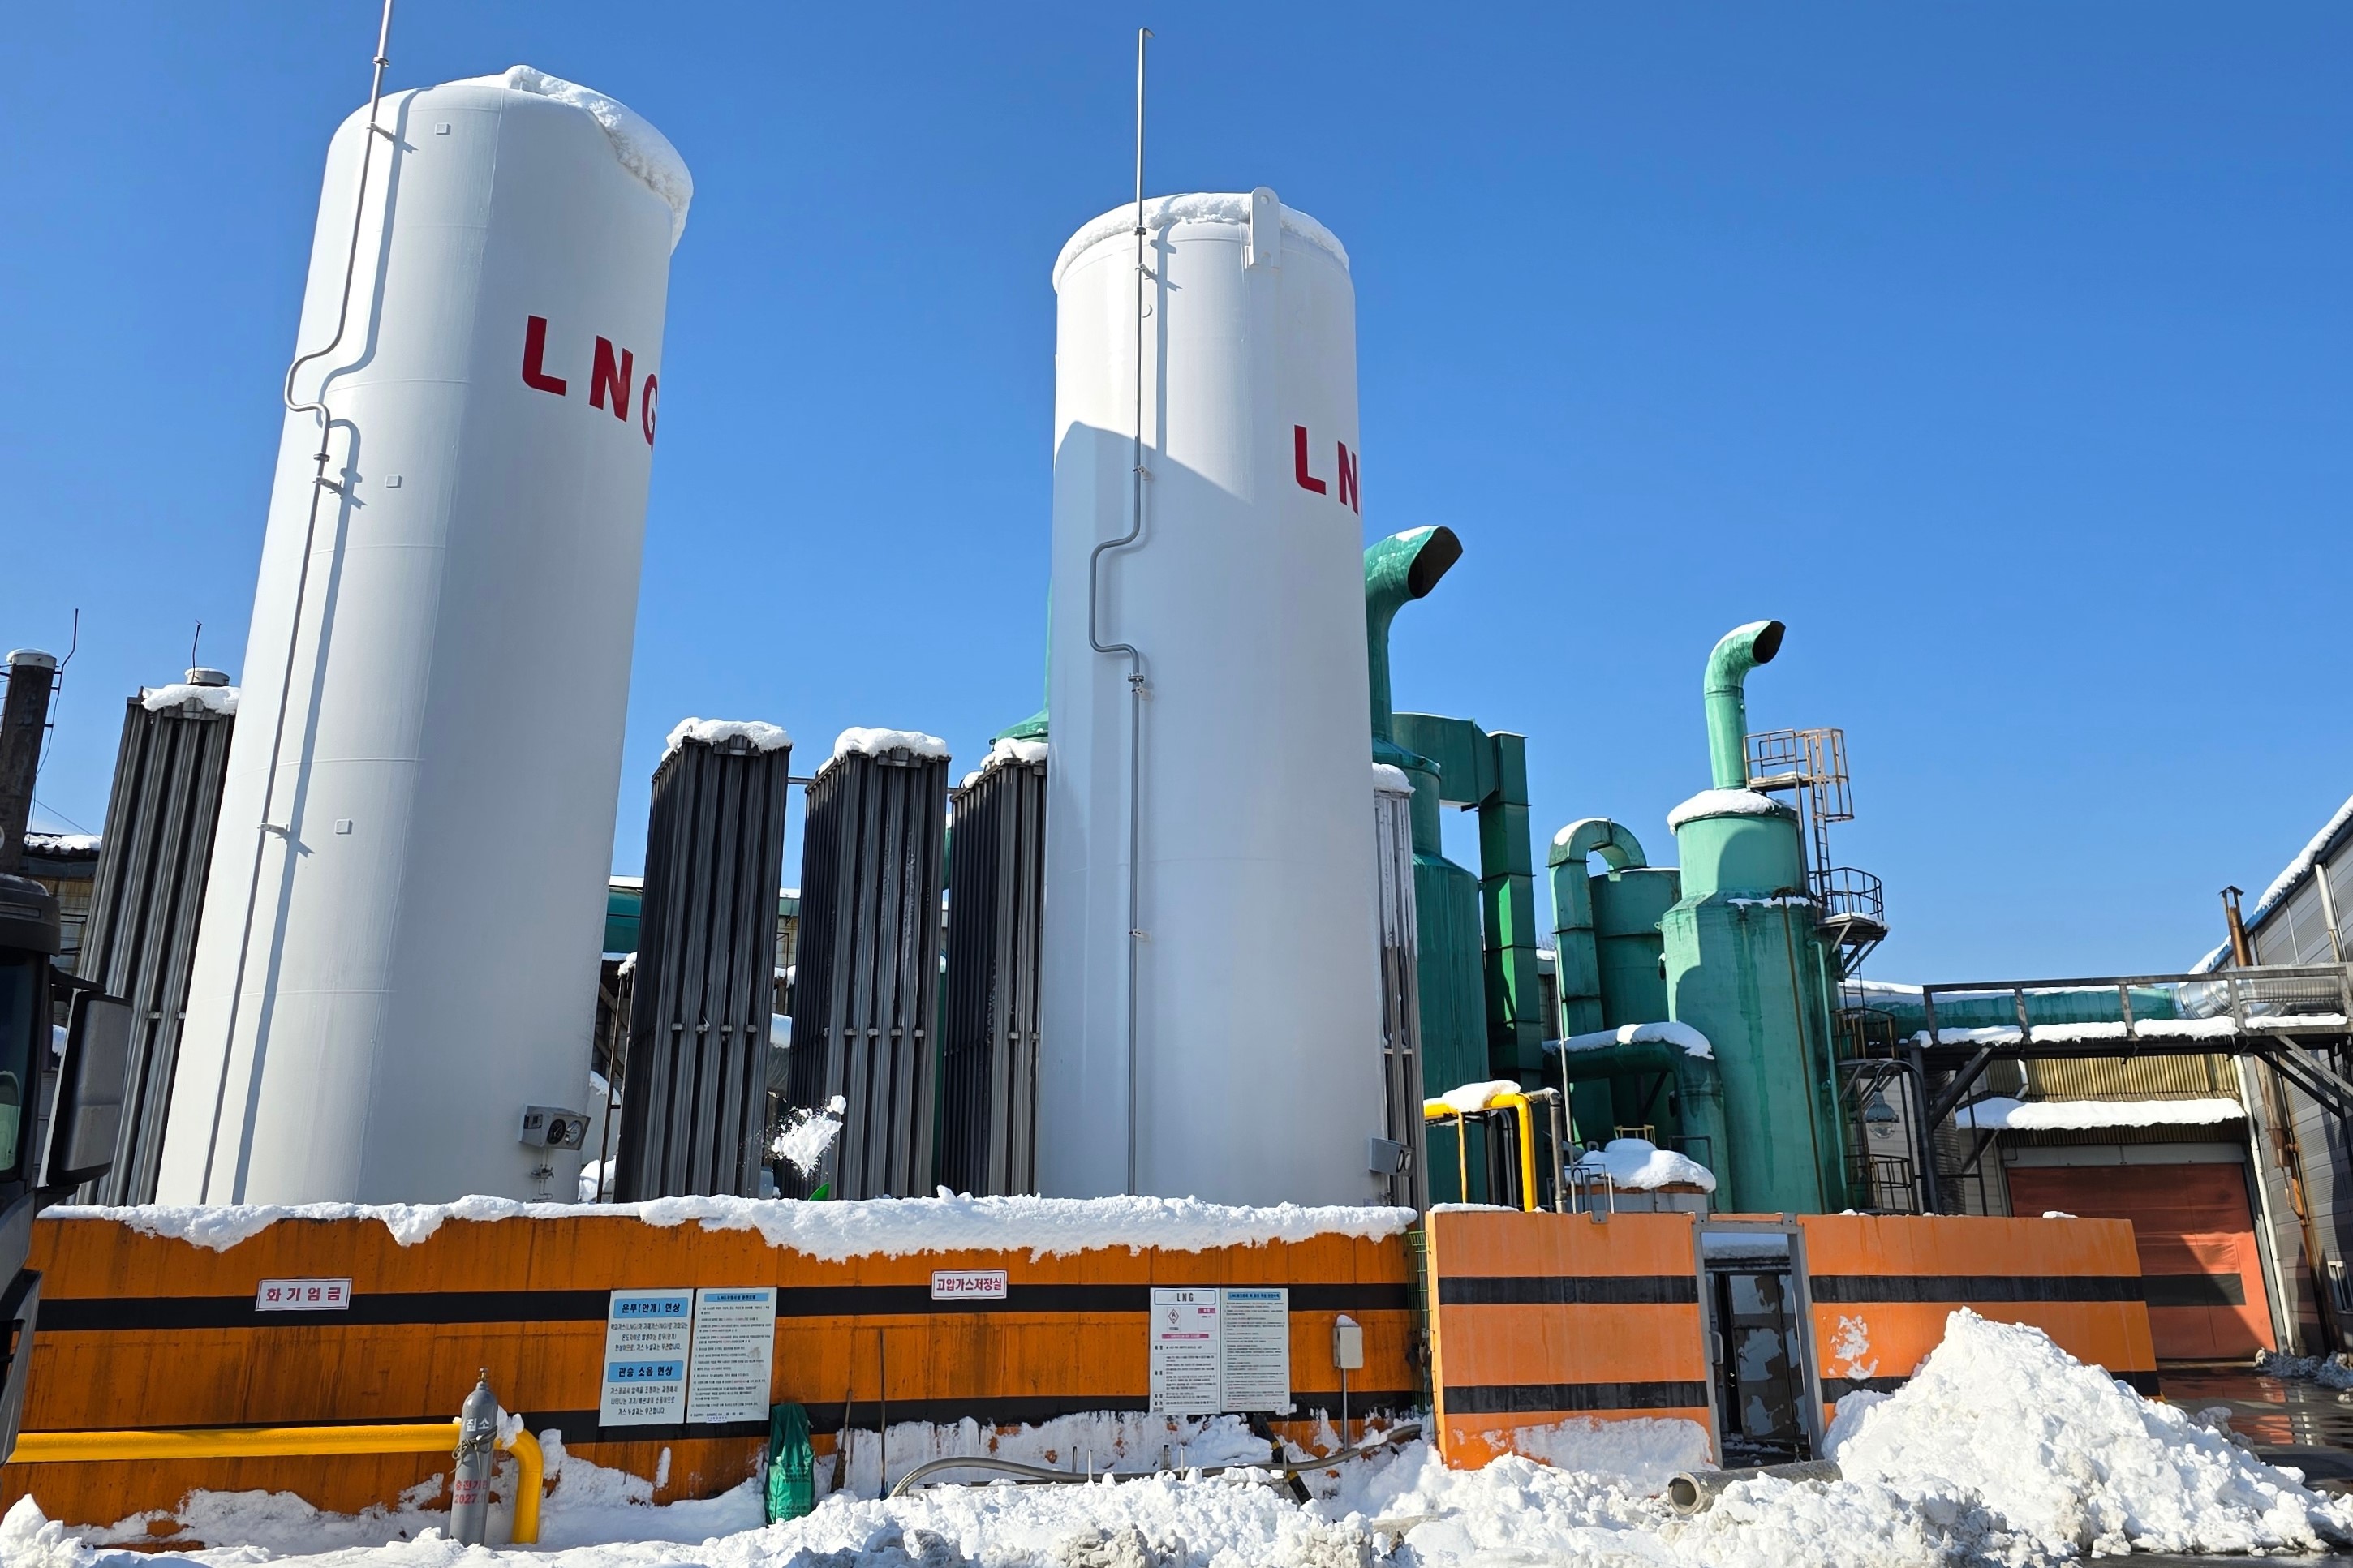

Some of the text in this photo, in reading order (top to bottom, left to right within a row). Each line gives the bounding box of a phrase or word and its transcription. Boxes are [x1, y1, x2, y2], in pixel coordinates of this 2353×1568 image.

[522, 314, 658, 453] LNG
[1293, 423, 1362, 516] LN
[936, 1278, 1002, 1291] 고압가스저장실
[265, 1287, 342, 1302] 화기엄금
[1176, 1292, 1194, 1302] LNG
[665, 1302, 681, 1313] 현상
[638, 1366, 653, 1377] 소음
[657, 1366, 673, 1377] 현상
[466, 1417, 490, 1432] 질소
